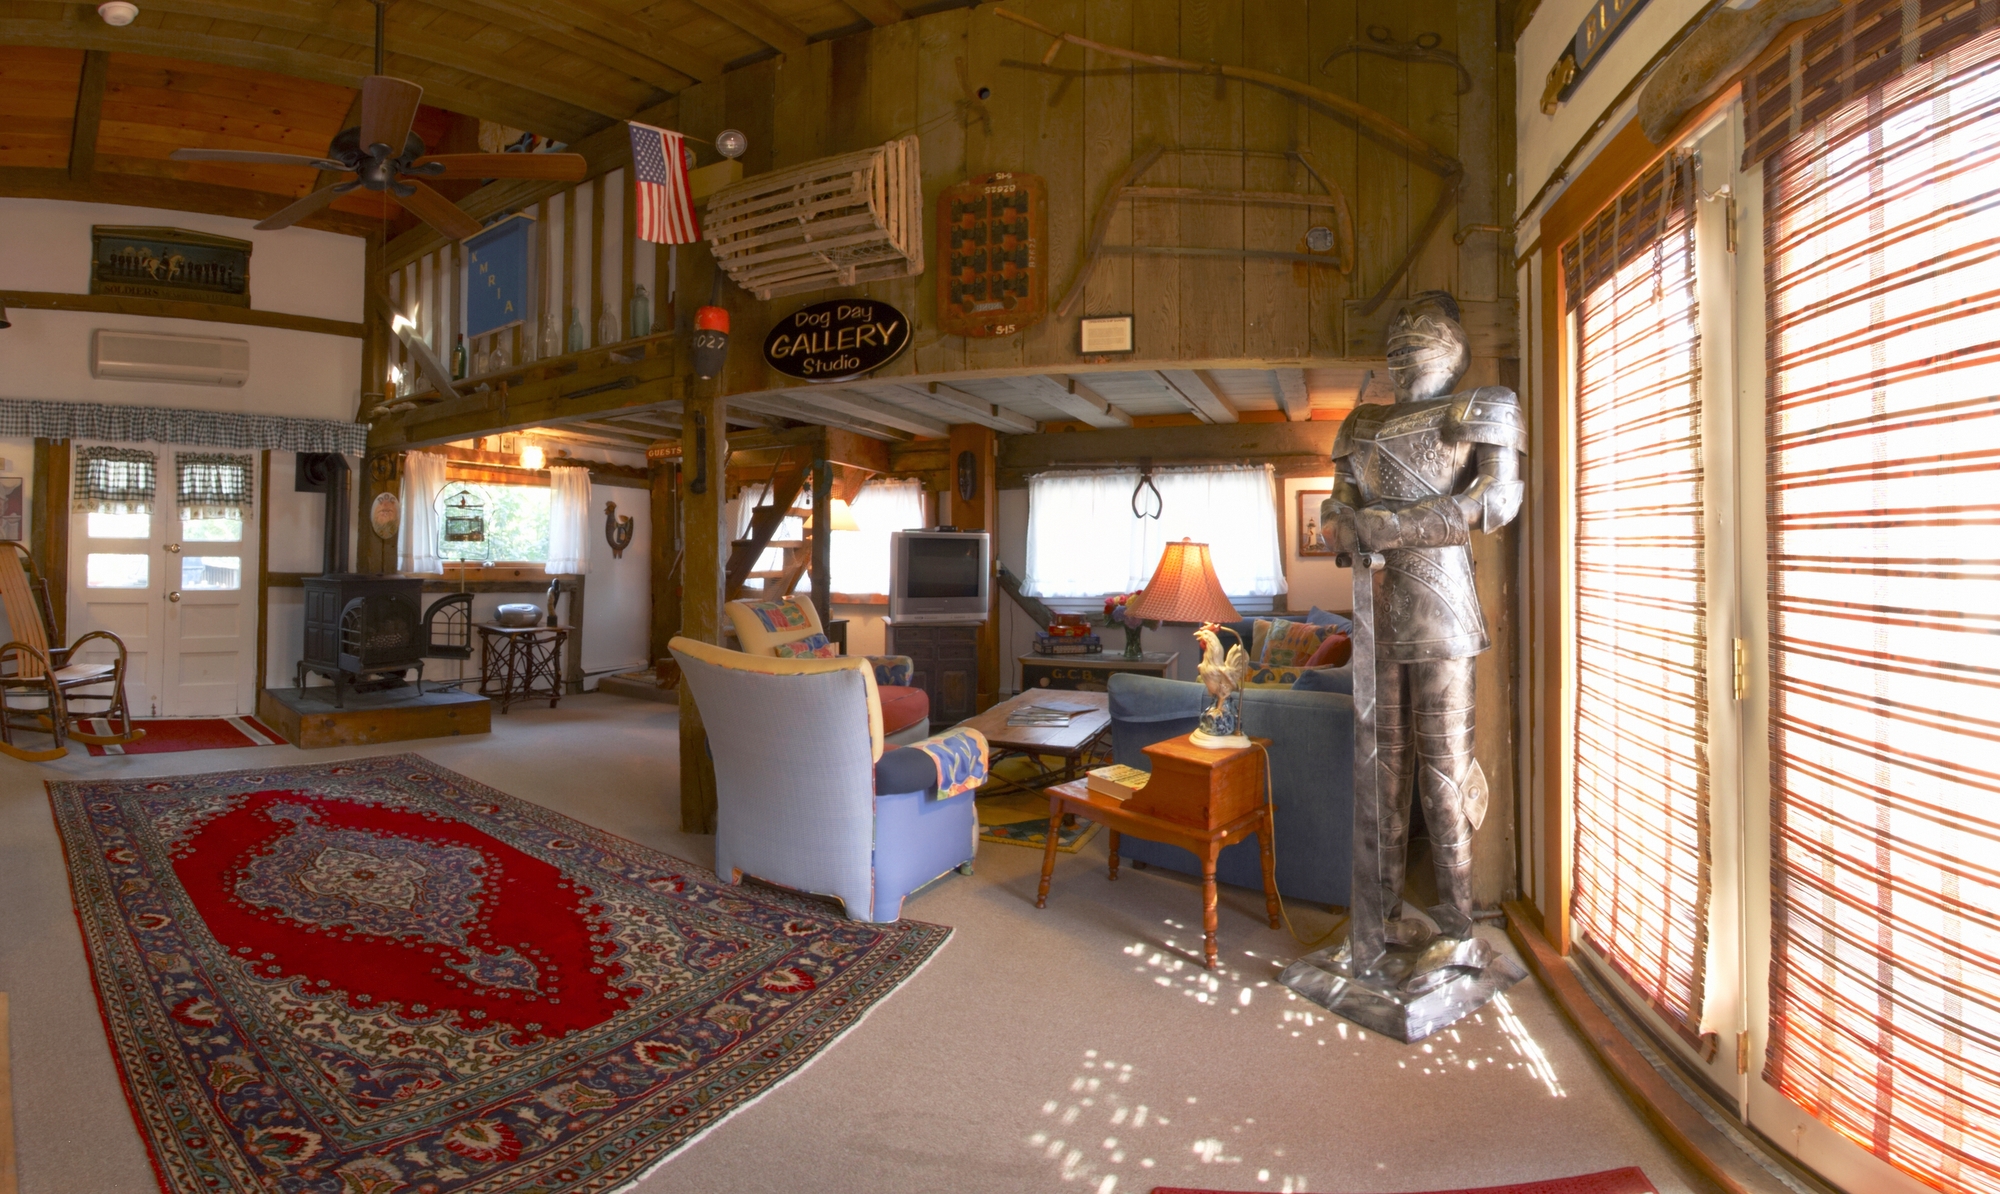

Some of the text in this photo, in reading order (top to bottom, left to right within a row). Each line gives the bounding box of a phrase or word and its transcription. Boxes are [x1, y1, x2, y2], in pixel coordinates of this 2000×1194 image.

[104, 284, 158, 296] SOLDIERS
[794, 305, 872, 328] Dog Day
[770, 320, 899, 359] GALLERY
[803, 354, 860, 375] Studio
[648, 446, 682, 457] GUESTS
